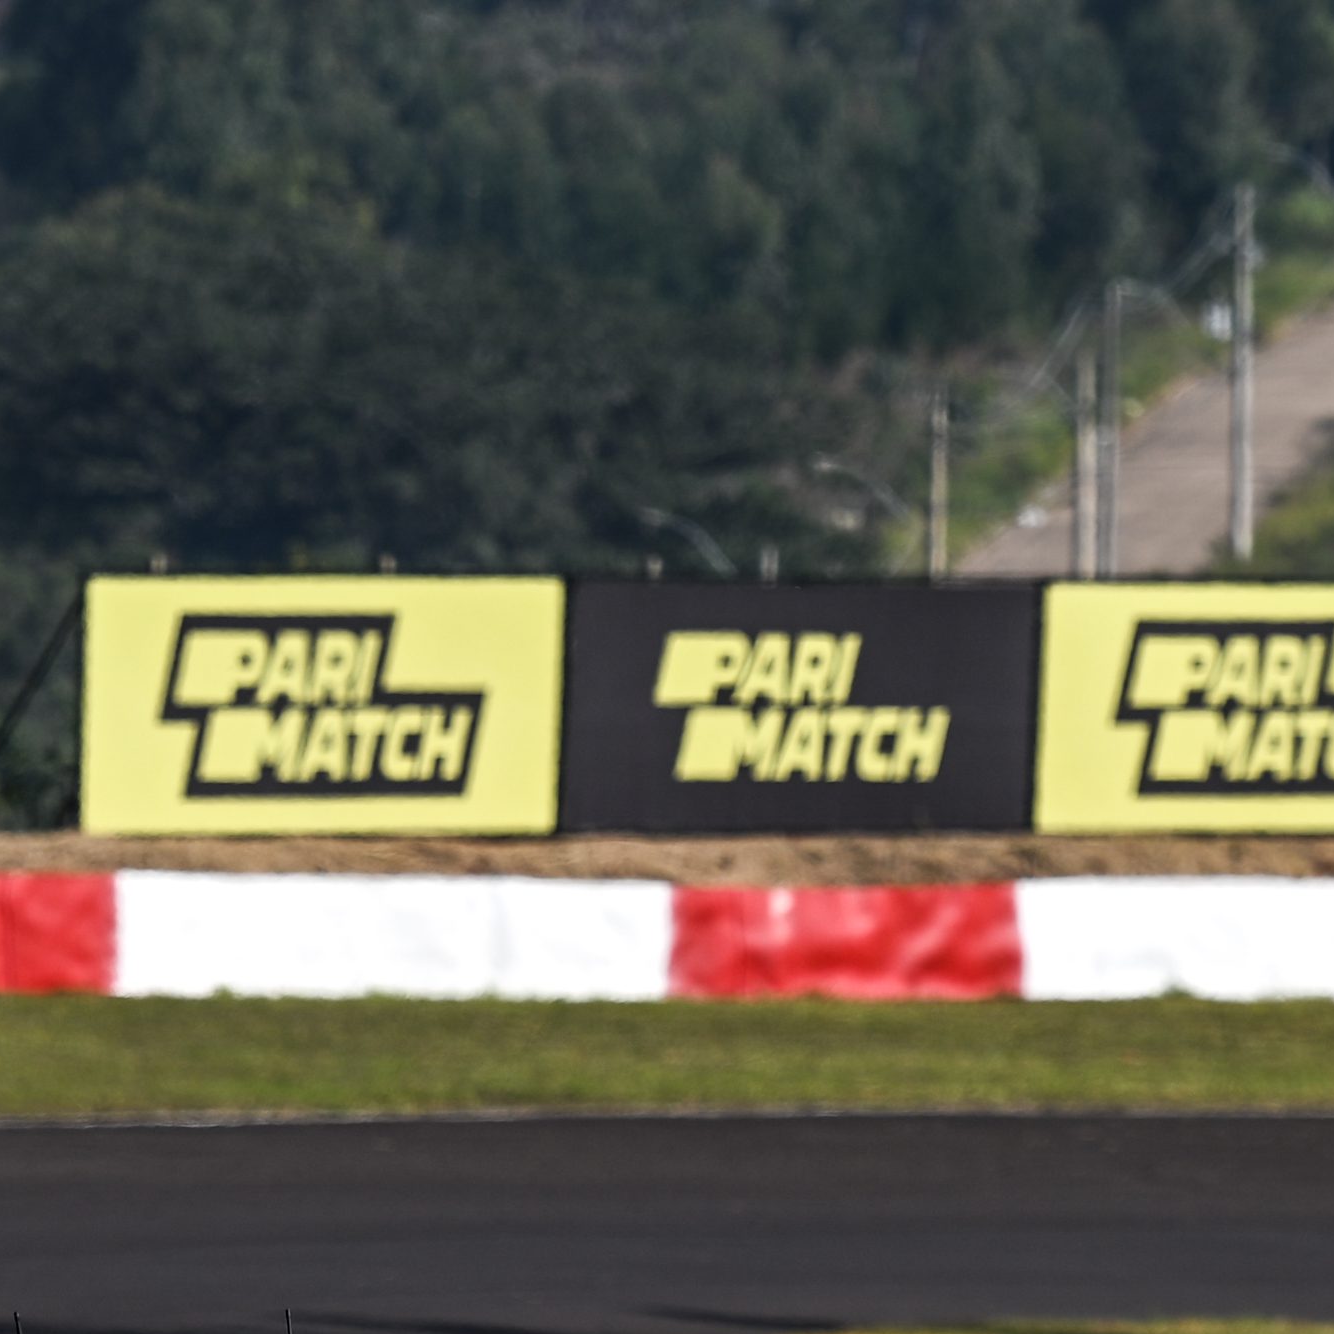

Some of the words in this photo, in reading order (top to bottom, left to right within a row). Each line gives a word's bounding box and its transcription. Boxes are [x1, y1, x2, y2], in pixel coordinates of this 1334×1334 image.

[172, 629, 383, 706] PARI
[654, 631, 862, 706] PARI
[1128, 634, 1327, 709] PARI
[196, 706, 473, 783] MATCH
[674, 706, 950, 782] MATCH
